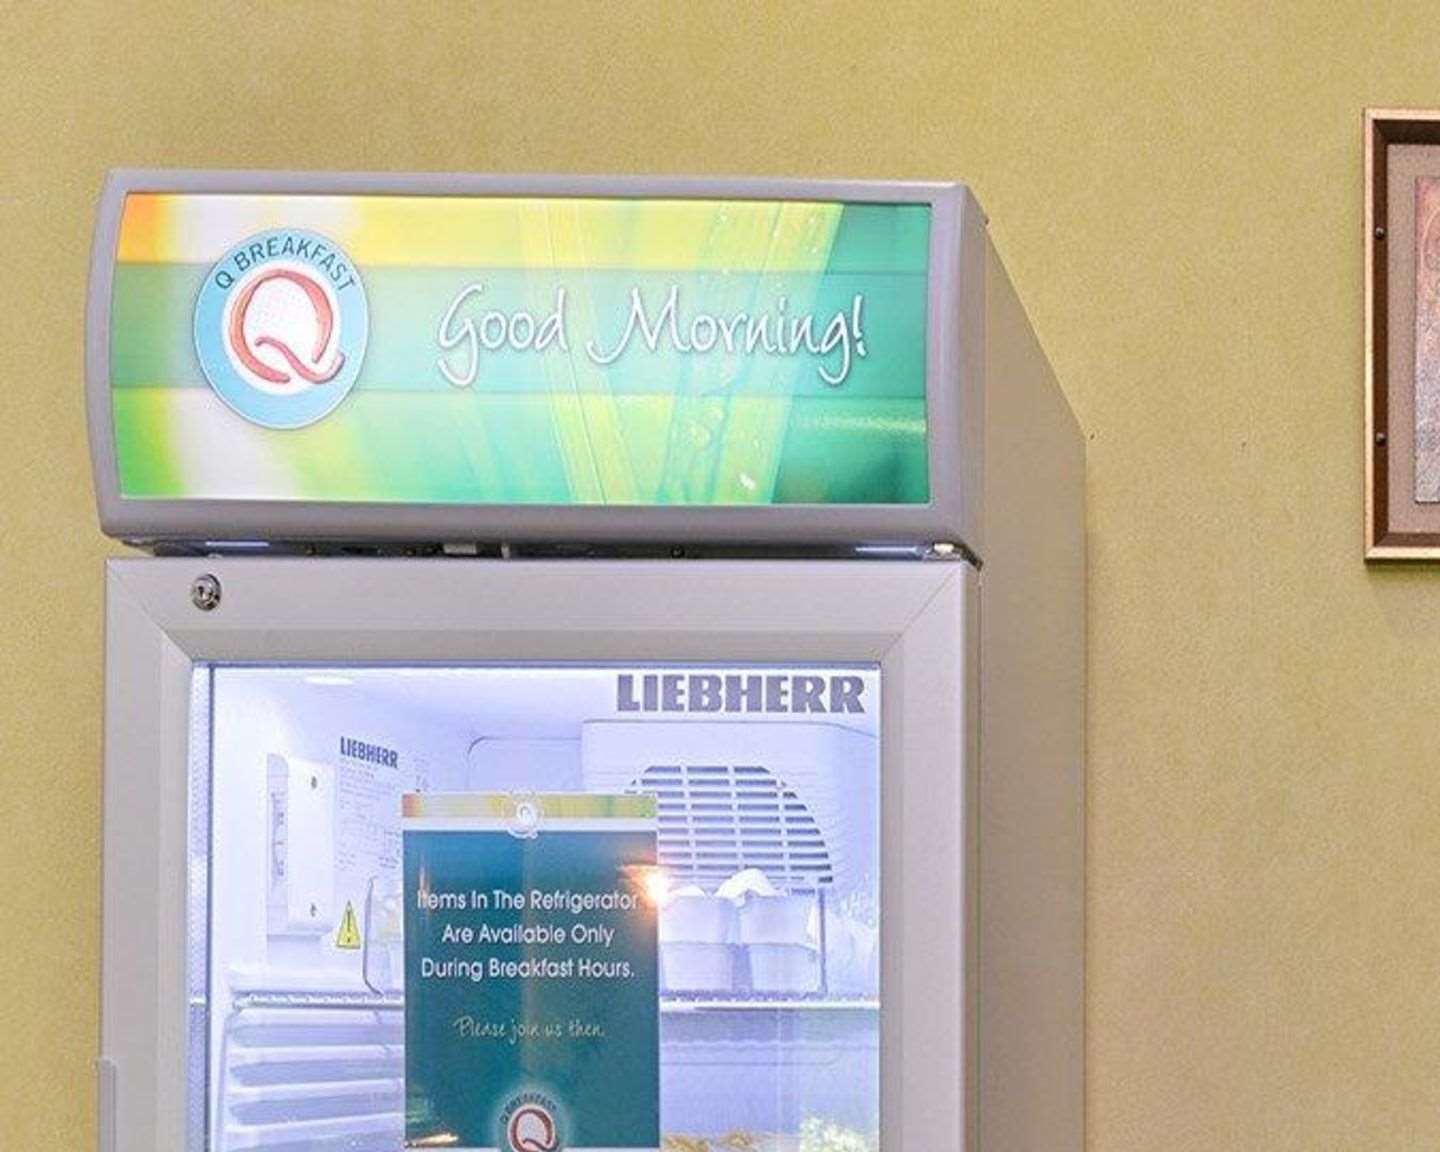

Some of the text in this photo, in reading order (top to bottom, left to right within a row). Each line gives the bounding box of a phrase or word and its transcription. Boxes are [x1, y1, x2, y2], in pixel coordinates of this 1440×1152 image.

[215, 236, 356, 291] Q BREAKFAST
[437, 283, 867, 387] Good Morning!
[616, 673, 866, 714] LIEBHERR
[340, 735, 399, 769] LIEBHERR
[417, 889, 639, 914] Items In The Refrigerator
[441, 924, 615, 947] Are Available Only
[421, 957, 635, 982] During Breakfast Hours.
[453, 1015, 506, 1038] Please
[510, 1019, 541, 1045] join
[545, 1025, 563, 1038] us
